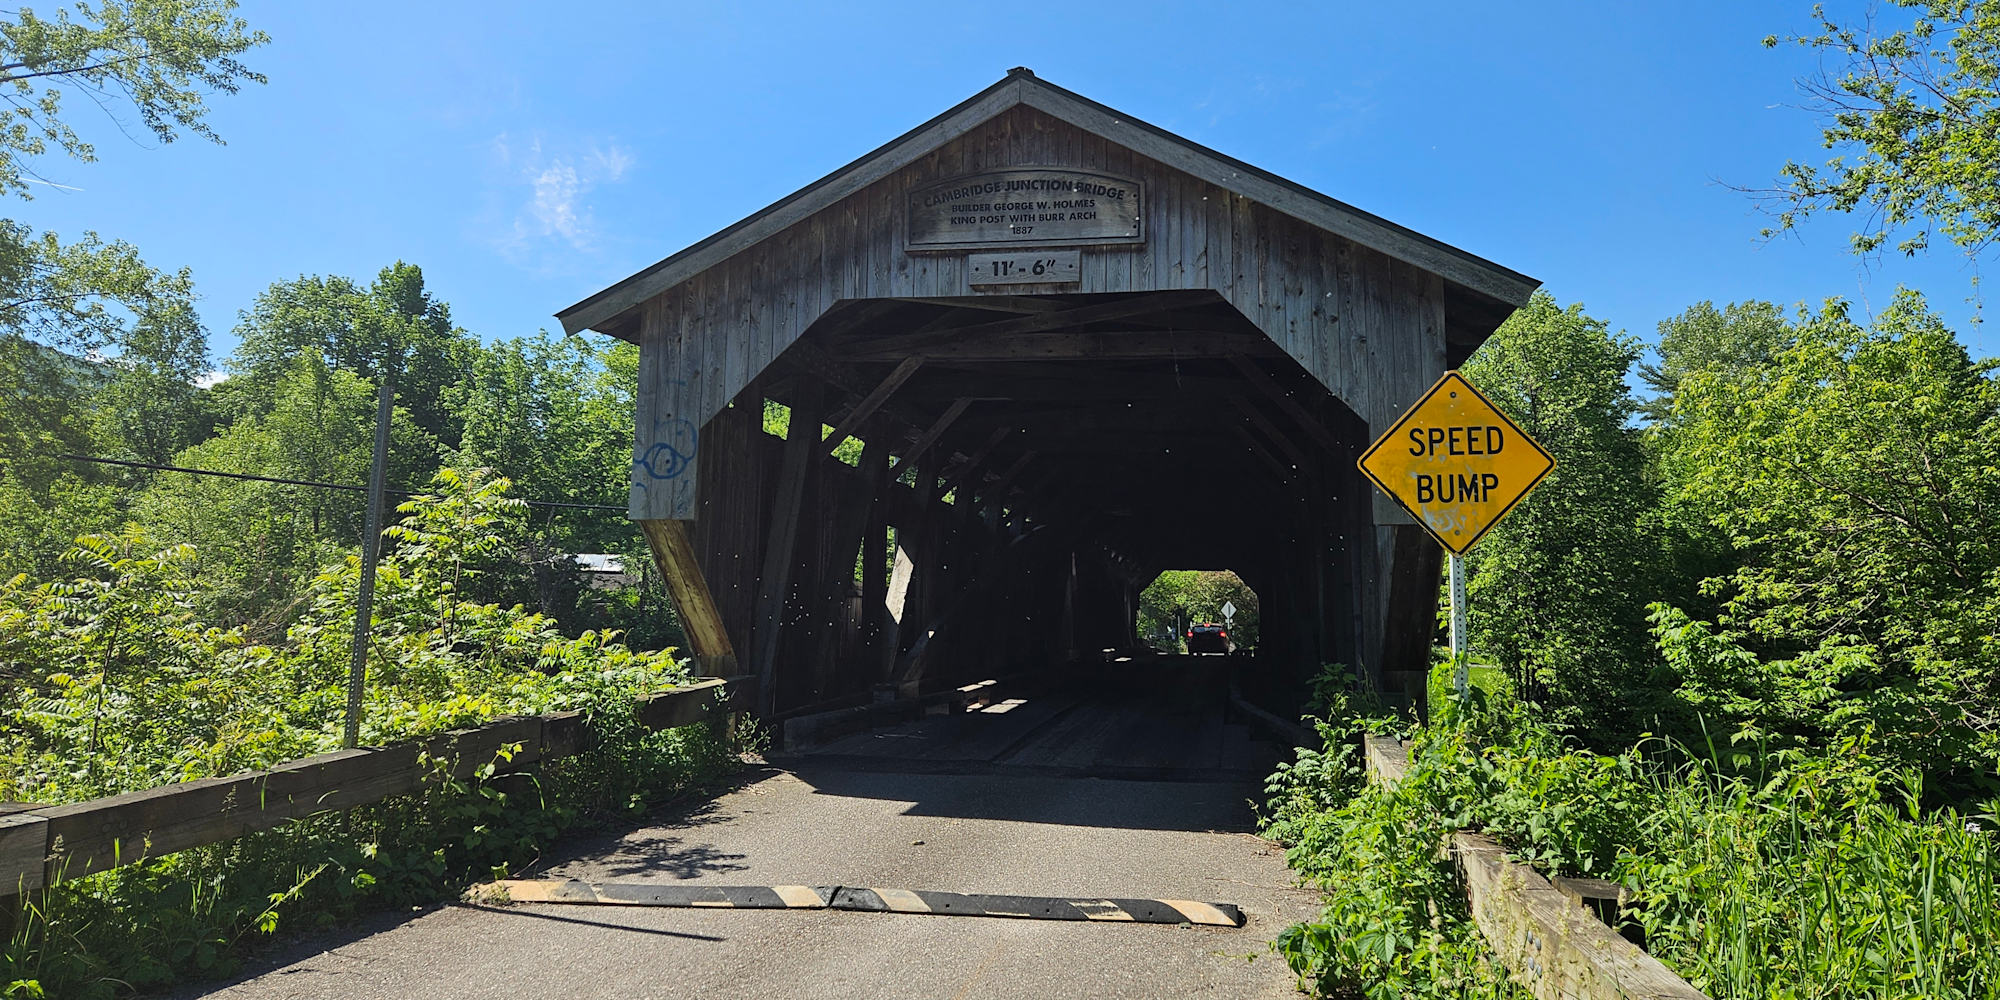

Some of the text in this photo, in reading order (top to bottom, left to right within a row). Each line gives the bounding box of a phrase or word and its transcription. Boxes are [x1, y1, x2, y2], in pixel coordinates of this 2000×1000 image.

[924, 180, 1125, 207] CAMBRIDGE JUNCTION BRIDGE
[952, 199, 1095, 213] BUILDER GEORGE W. HOLMES
[951, 211, 1097, 225] KING POST WITH BURR ARCH
[1012, 226, 1033, 235] 1887
[1409, 426, 1504, 456] SPEED
[1416, 474, 1499, 503] BUMP
